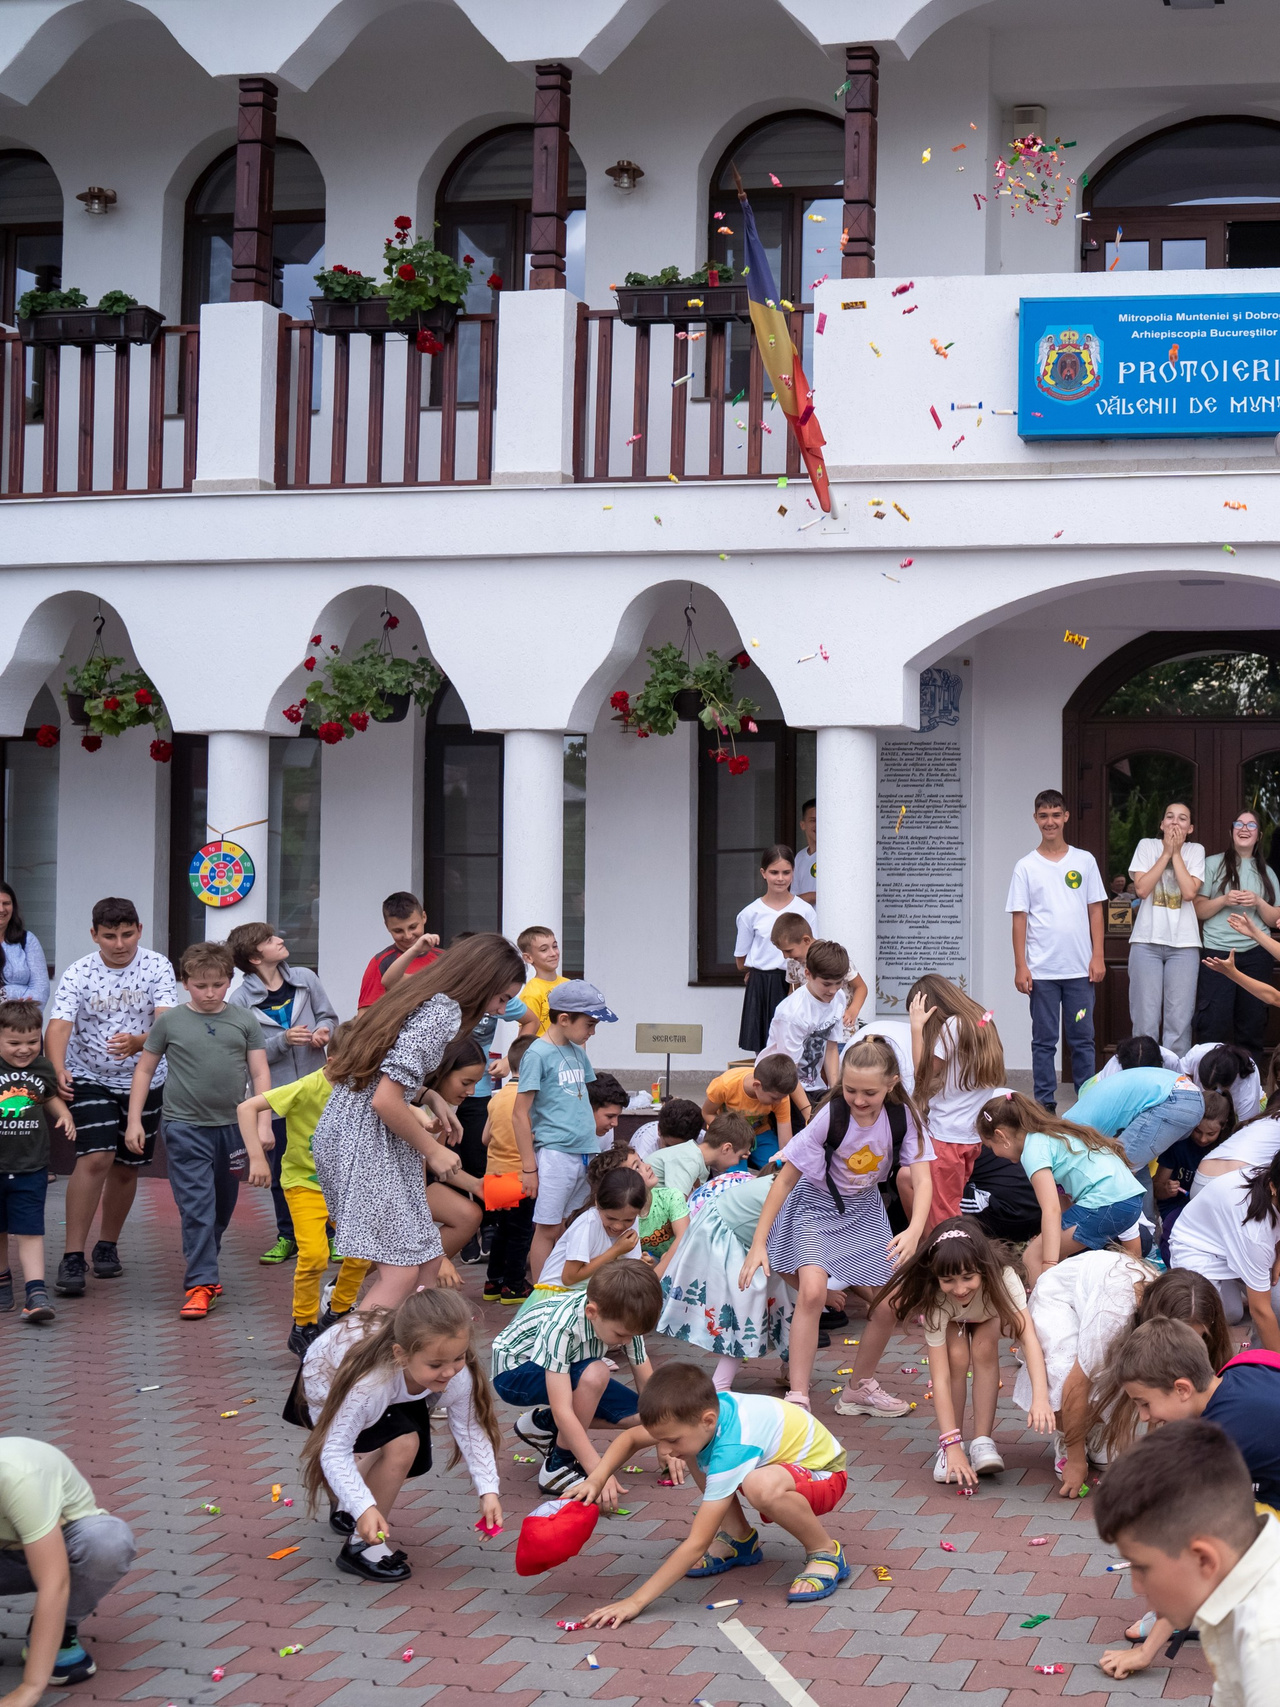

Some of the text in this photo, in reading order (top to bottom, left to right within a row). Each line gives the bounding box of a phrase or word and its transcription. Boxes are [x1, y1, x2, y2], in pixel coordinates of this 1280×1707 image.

[1118, 313, 1173, 324] Mitropolia
[1176, 312, 1229, 321] Munteniei
[1131, 329, 1207, 340] Arhiepiscopia
[1095, 395, 1177, 415] VĂLENII
[1189, 397, 1217, 414] DE
[0, 1071, 45, 1094] NOSAUR
[0, 1120, 39, 1129] PLORERS
